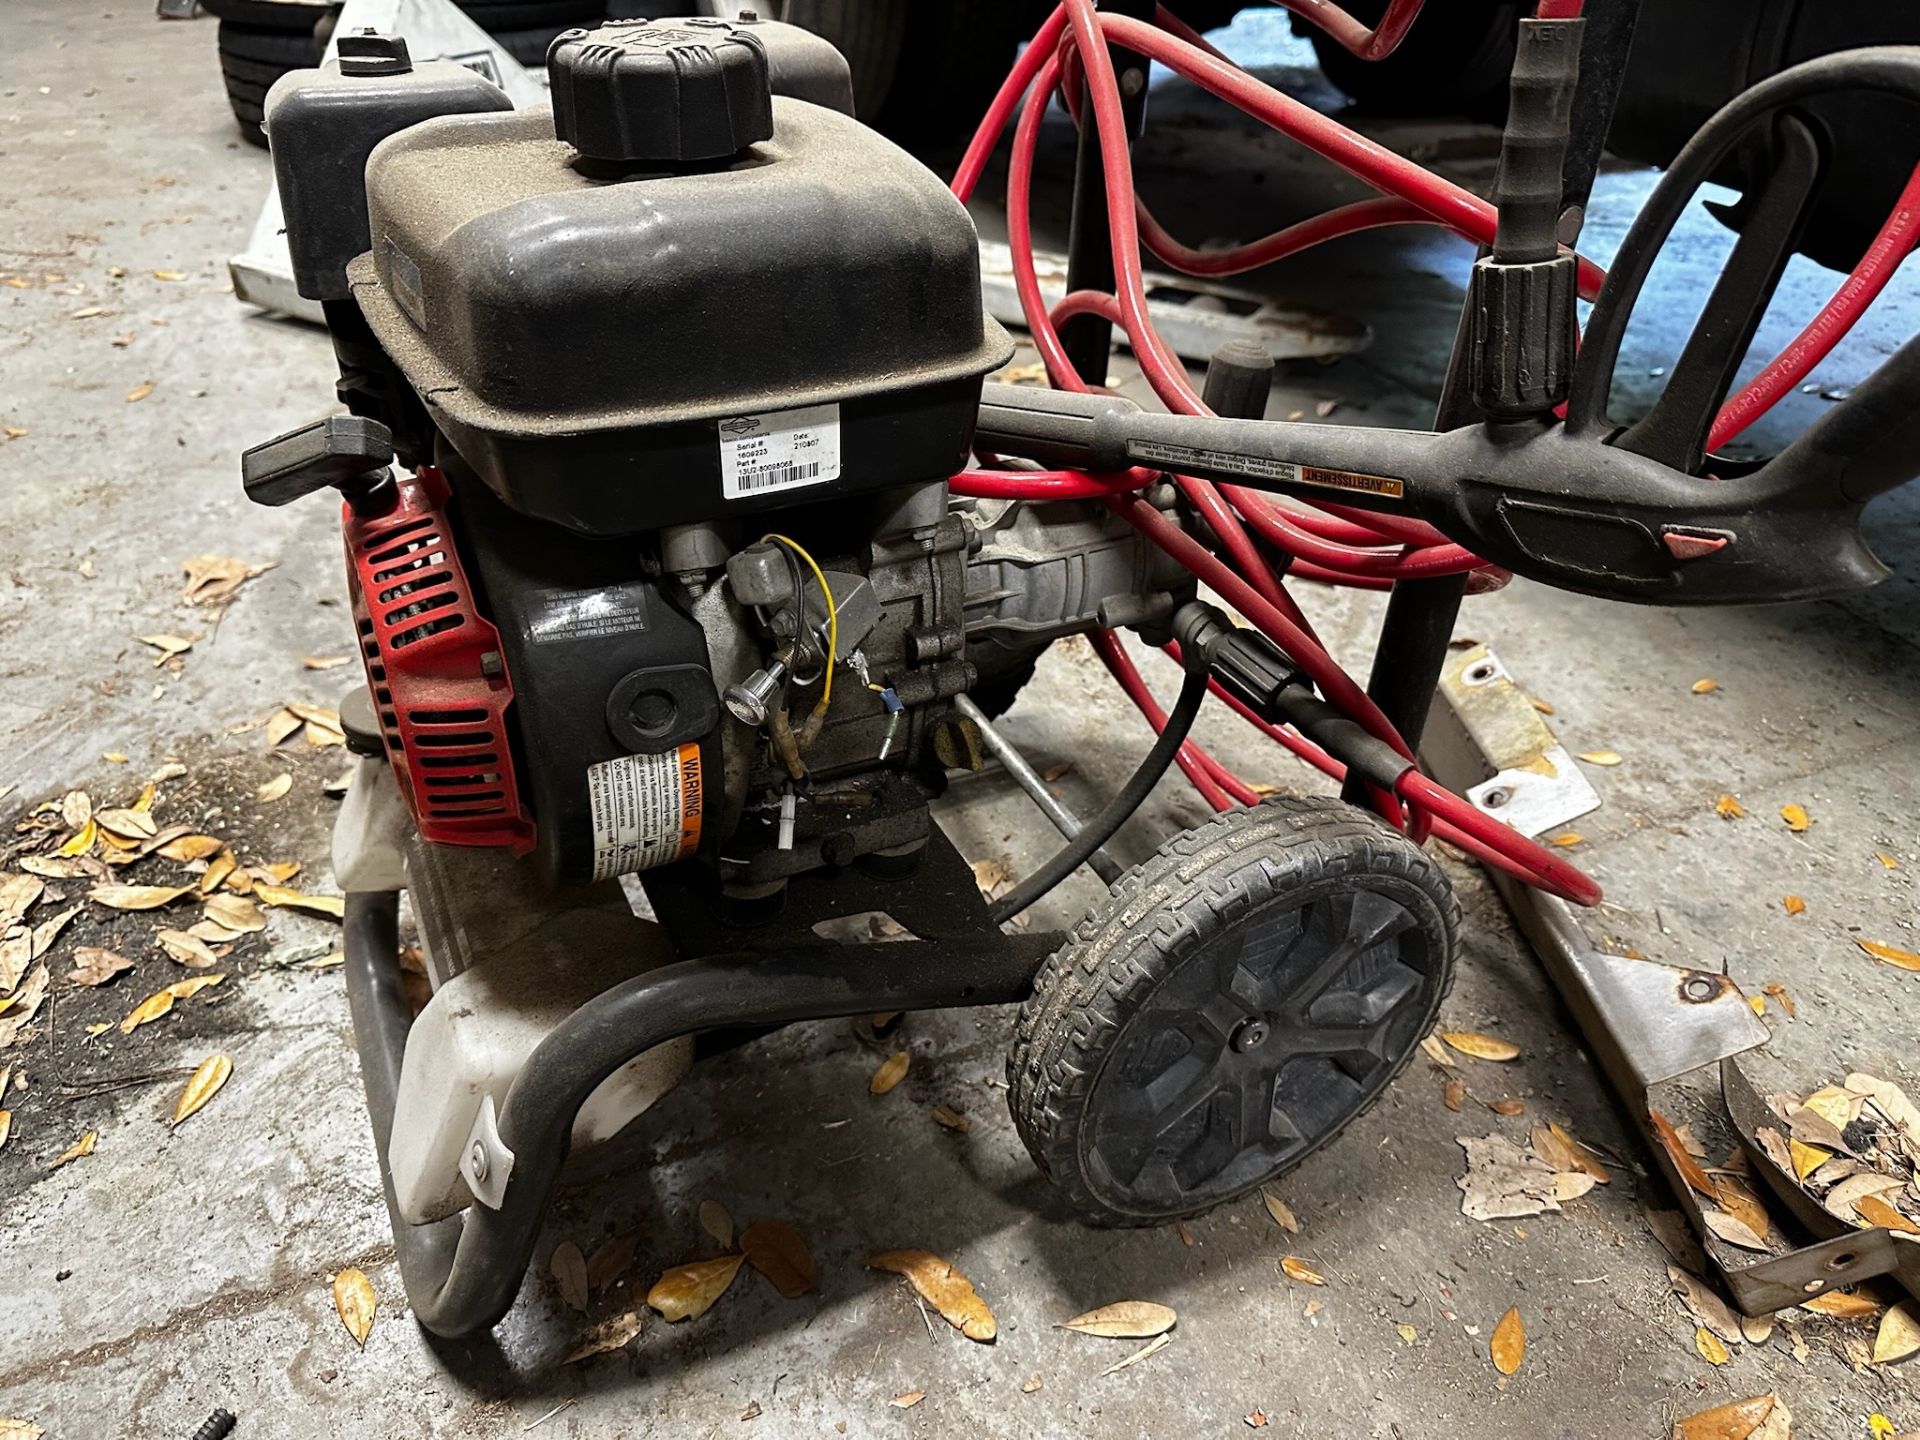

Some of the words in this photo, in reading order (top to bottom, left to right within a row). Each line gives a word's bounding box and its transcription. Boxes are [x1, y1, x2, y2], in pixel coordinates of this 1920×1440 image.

[737, 442, 756, 451] Serial
[1305, 470, 1382, 491] AVERTISSEMENT
[613, 761, 622, 771] DO
[623, 760, 634, 780] Engines
[615, 771, 624, 782] NOT
[683, 758, 700, 817] WARNING
[628, 793, 636, 808] carbon
[672, 789, 681, 810] Operating
